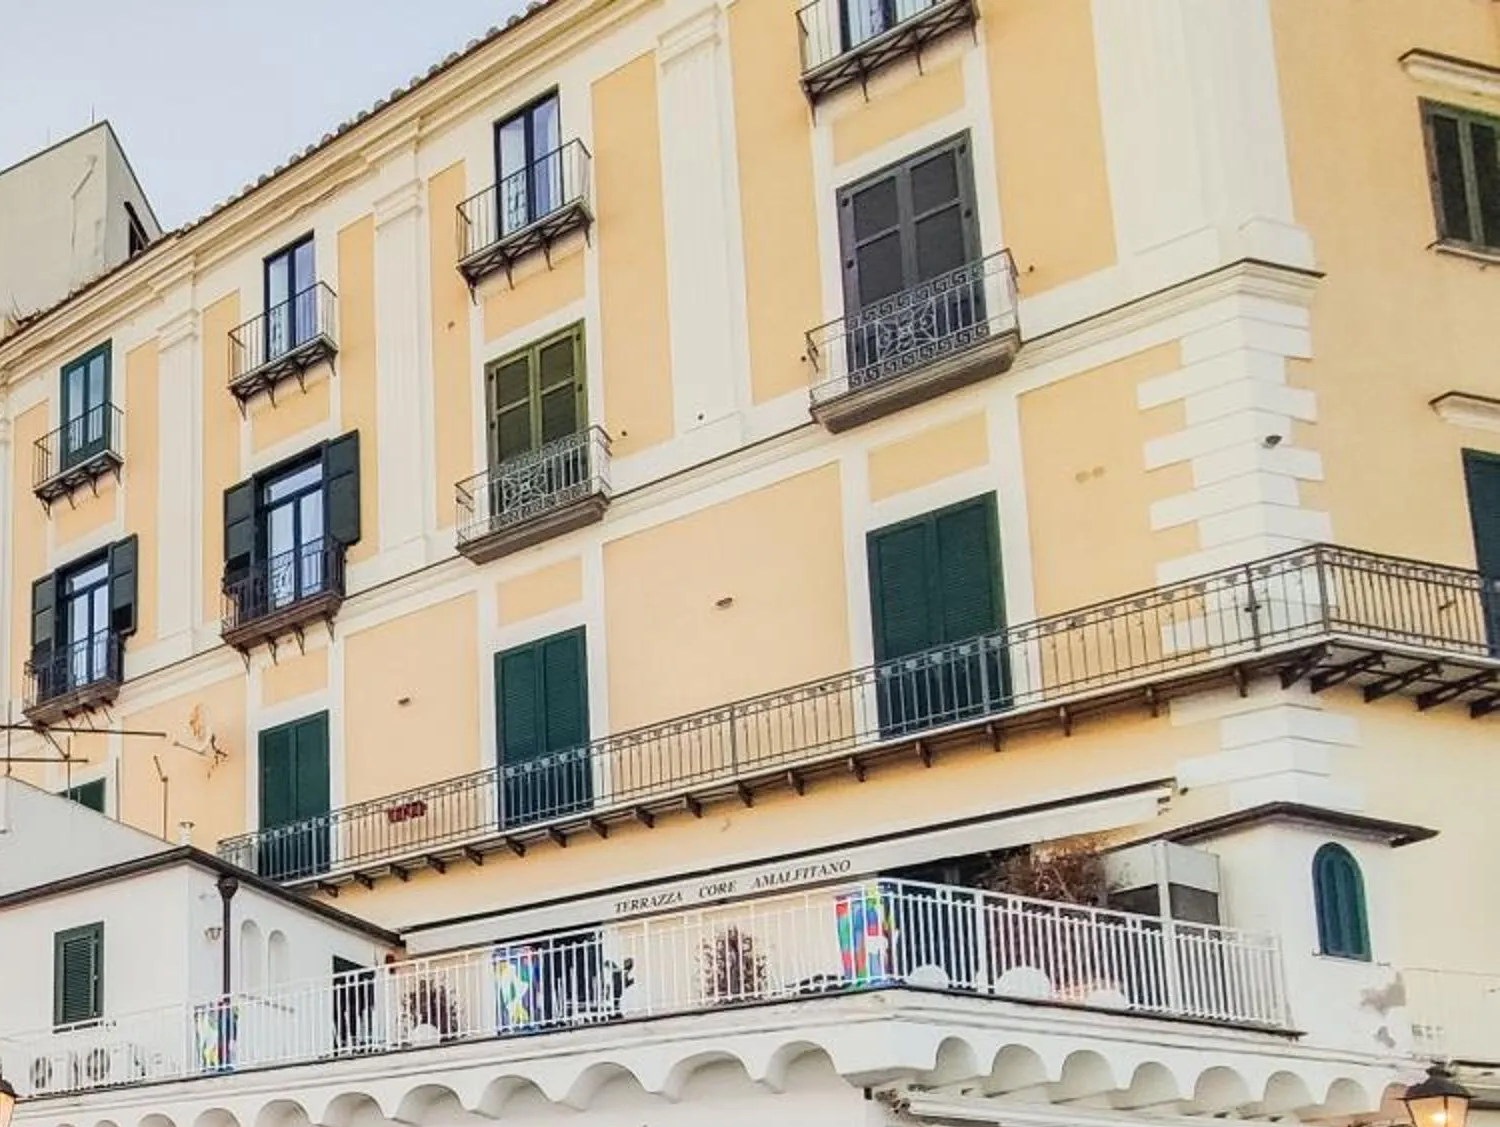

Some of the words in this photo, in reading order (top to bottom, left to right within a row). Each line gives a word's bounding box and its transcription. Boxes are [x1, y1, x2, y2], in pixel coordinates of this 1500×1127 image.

[614, 890, 684, 914] TERRAZZA
[698, 879, 737, 899] CORE
[752, 859, 852, 890] AMALFITANO
